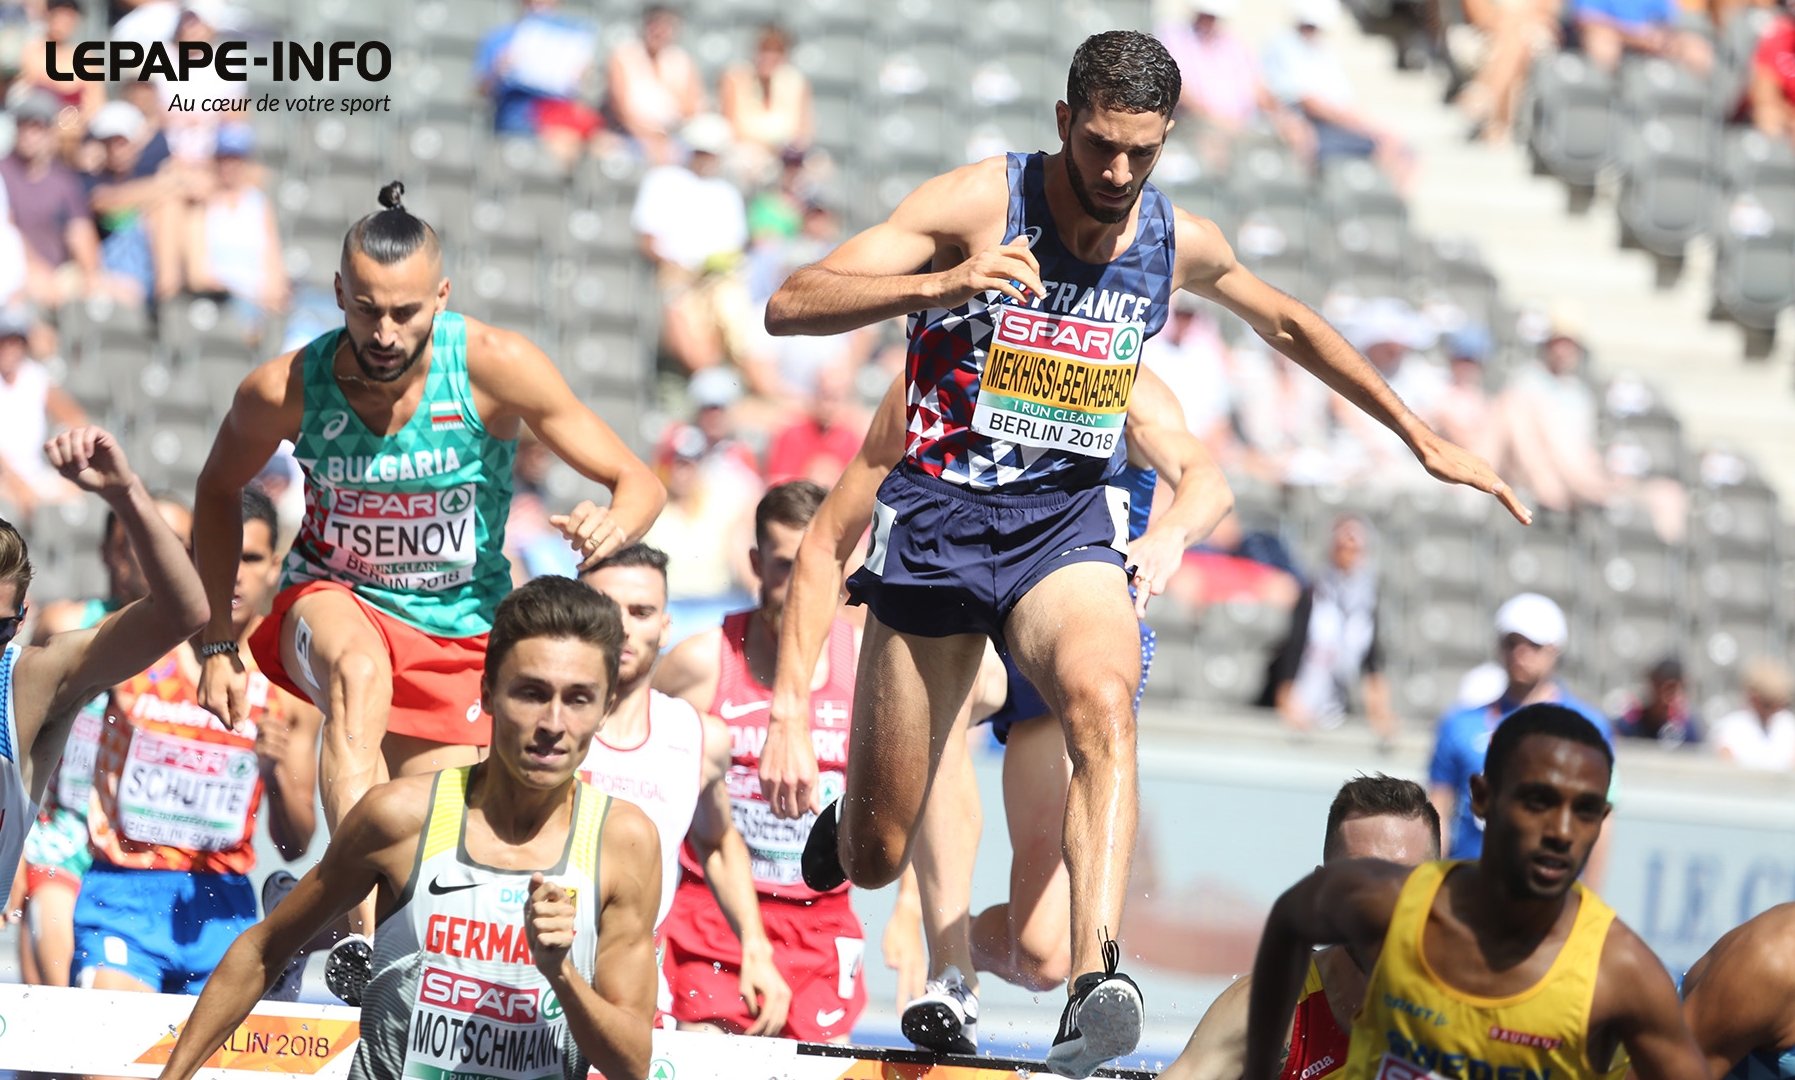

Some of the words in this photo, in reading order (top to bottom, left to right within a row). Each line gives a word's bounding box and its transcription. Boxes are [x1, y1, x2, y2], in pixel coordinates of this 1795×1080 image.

[1031, 278, 1152, 324] FRANCE
[1002, 315, 1111, 358] SPAR
[986, 348, 1132, 409] MEKHISSI-BENABBAD
[988, 411, 1064, 443] BERLIN
[1067, 428, 1114, 451] 2018
[1022, 403, 1051, 419] RUN
[327, 446, 461, 484] BULGARIA
[336, 490, 435, 517] SPAR
[331, 518, 468, 558] TSENOV
[395, 562, 437, 574] CLEAN
[417, 569, 460, 591] 2018
[729, 725, 848, 763] DANRK
[127, 763, 247, 814] SCHUTTE
[425, 913, 536, 966] GERMA
[423, 972, 538, 1019] SPAR
[221, 1032, 270, 1055] LIN
[276, 1034, 330, 1058] 2018
[412, 1009, 563, 1072] MOTSCHMANN
[1301, 1055, 1335, 1080] oma
